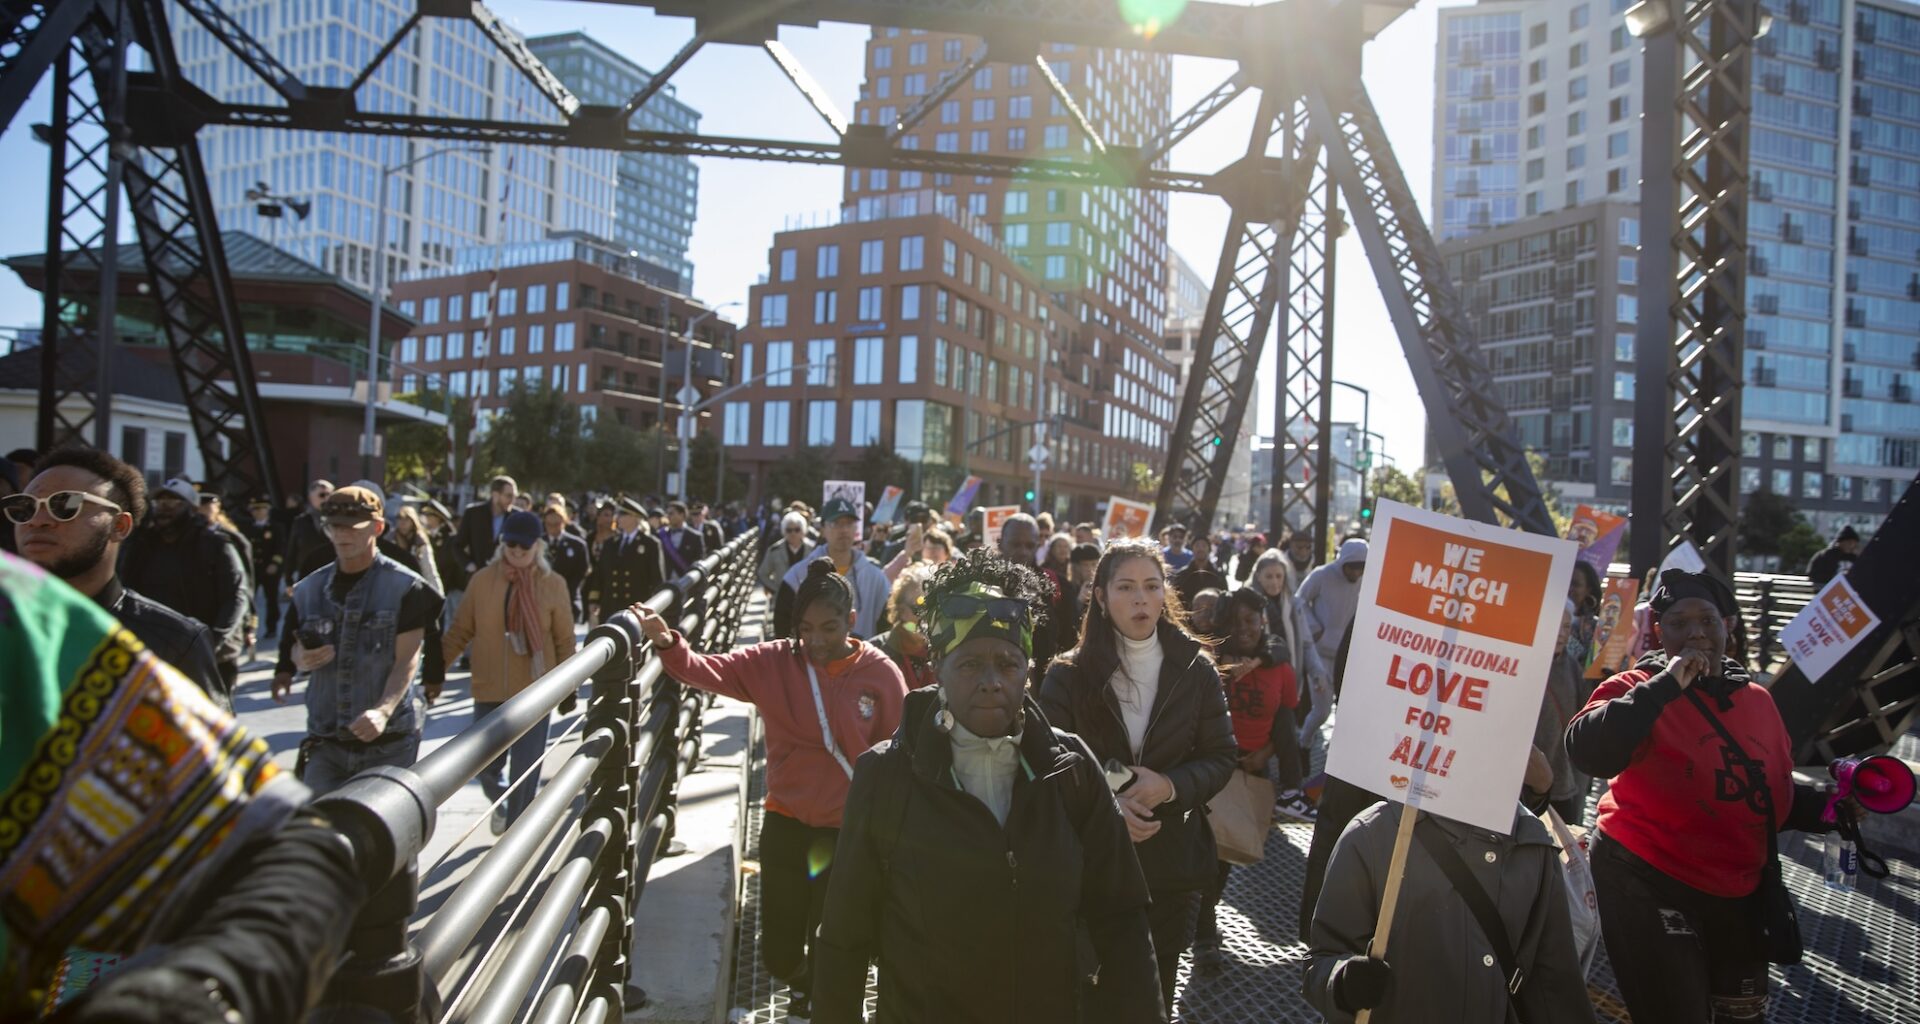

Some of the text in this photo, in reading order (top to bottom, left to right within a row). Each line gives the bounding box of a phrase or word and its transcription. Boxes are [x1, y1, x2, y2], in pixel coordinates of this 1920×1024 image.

[1443, 542, 1485, 573] WE
[1410, 562, 1508, 606] MARCH
[1428, 595, 1475, 623] FOR
[1806, 633, 1817, 645] FOR
[1809, 617, 1833, 646] LOVE
[1377, 622, 1519, 676] UNCONDITIONAL
[1796, 640, 1813, 656] ALL!
[1386, 654, 1489, 711] LOVE
[1405, 706, 1451, 735] FOR
[1389, 736, 1456, 777] ALL!
